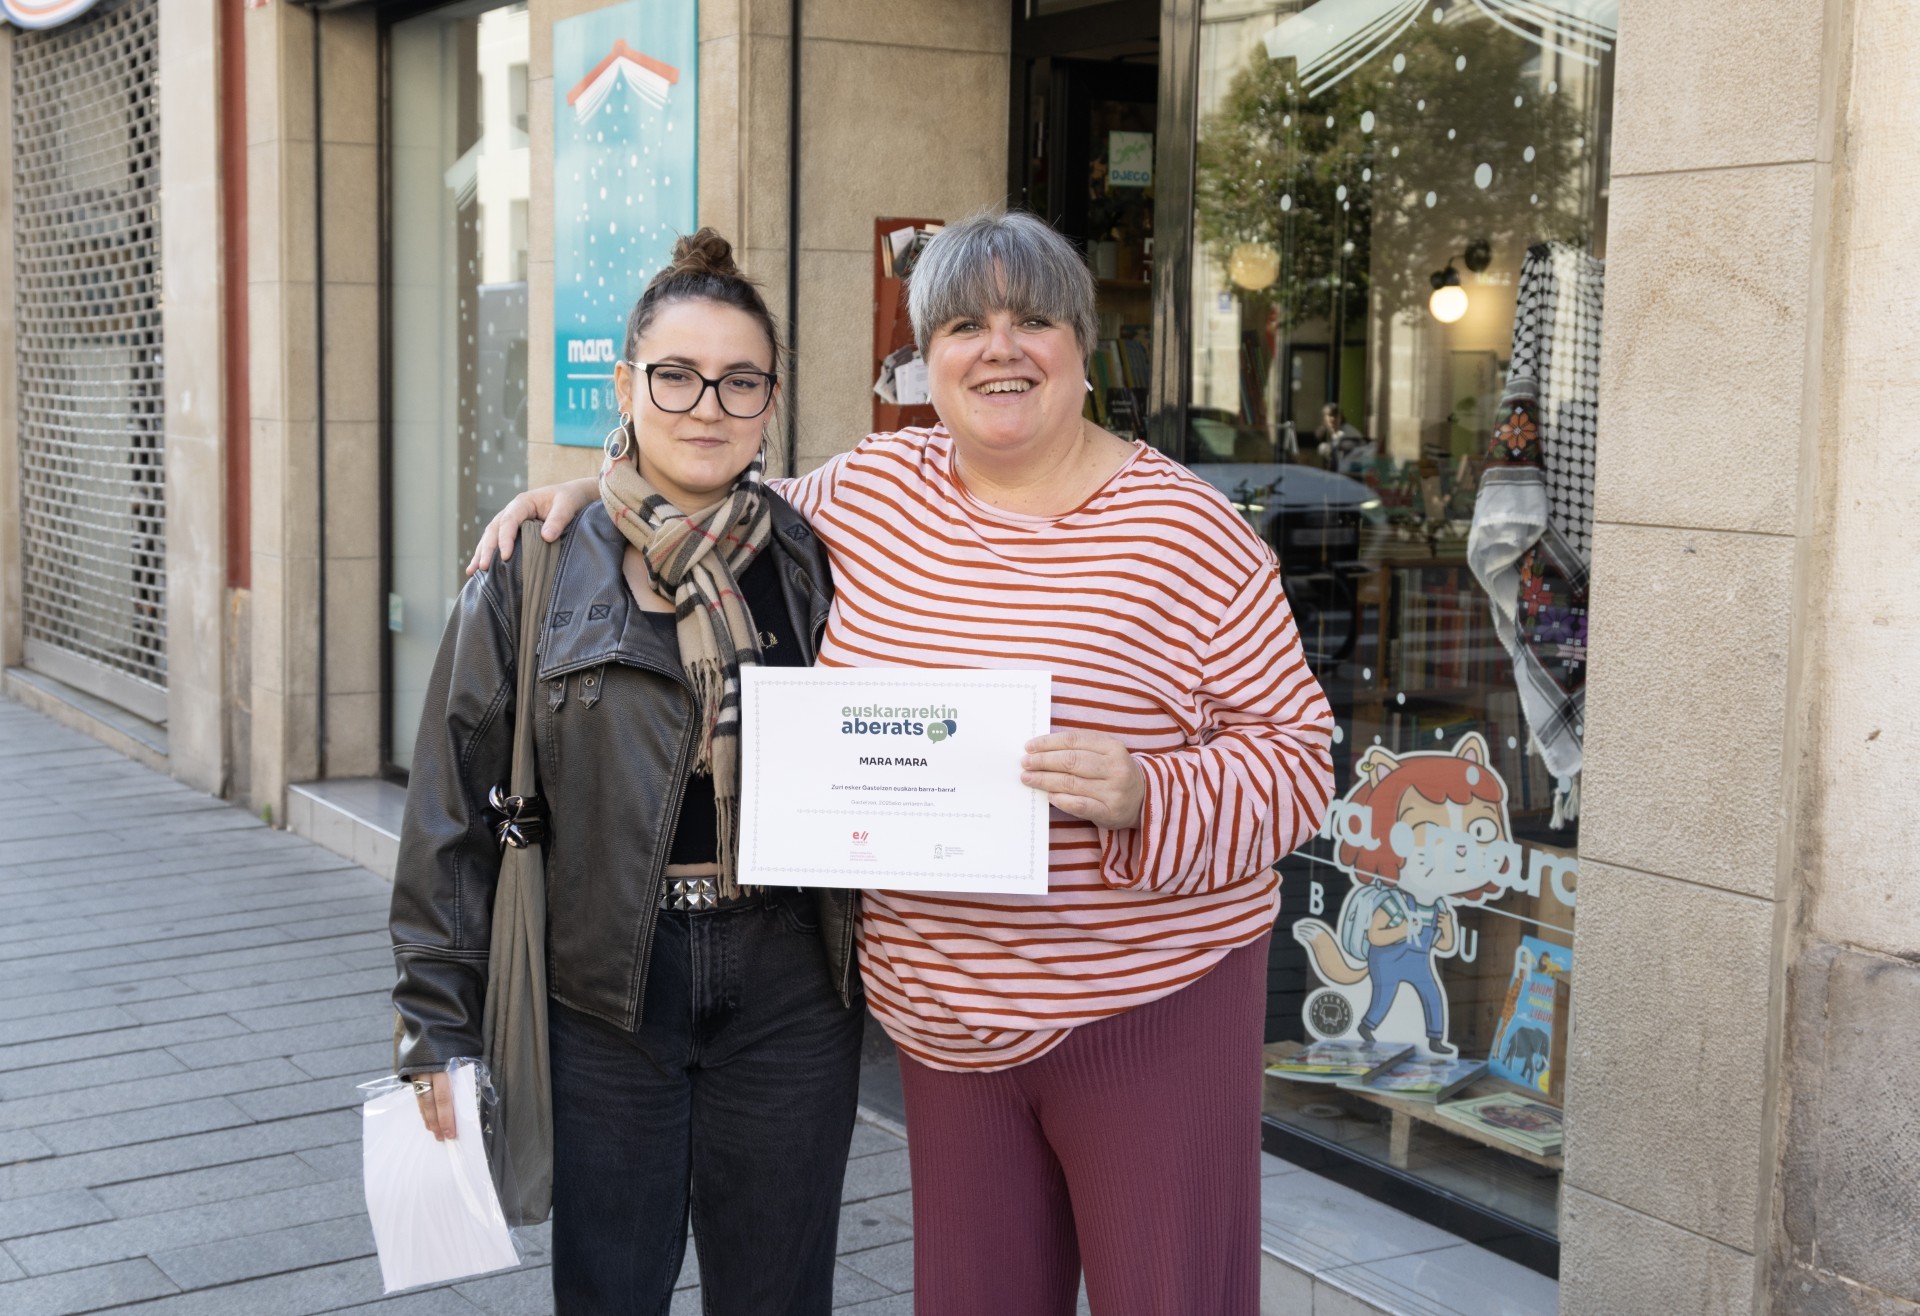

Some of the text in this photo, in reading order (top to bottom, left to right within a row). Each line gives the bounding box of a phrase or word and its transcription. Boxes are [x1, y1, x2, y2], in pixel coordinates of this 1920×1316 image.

[567, 338, 616, 363] mara
[568, 387, 615, 410] LIBU
[841, 703, 958, 719] euskararekin
[841, 718, 924, 736] aberats
[859, 756, 928, 767] MARA MARA
